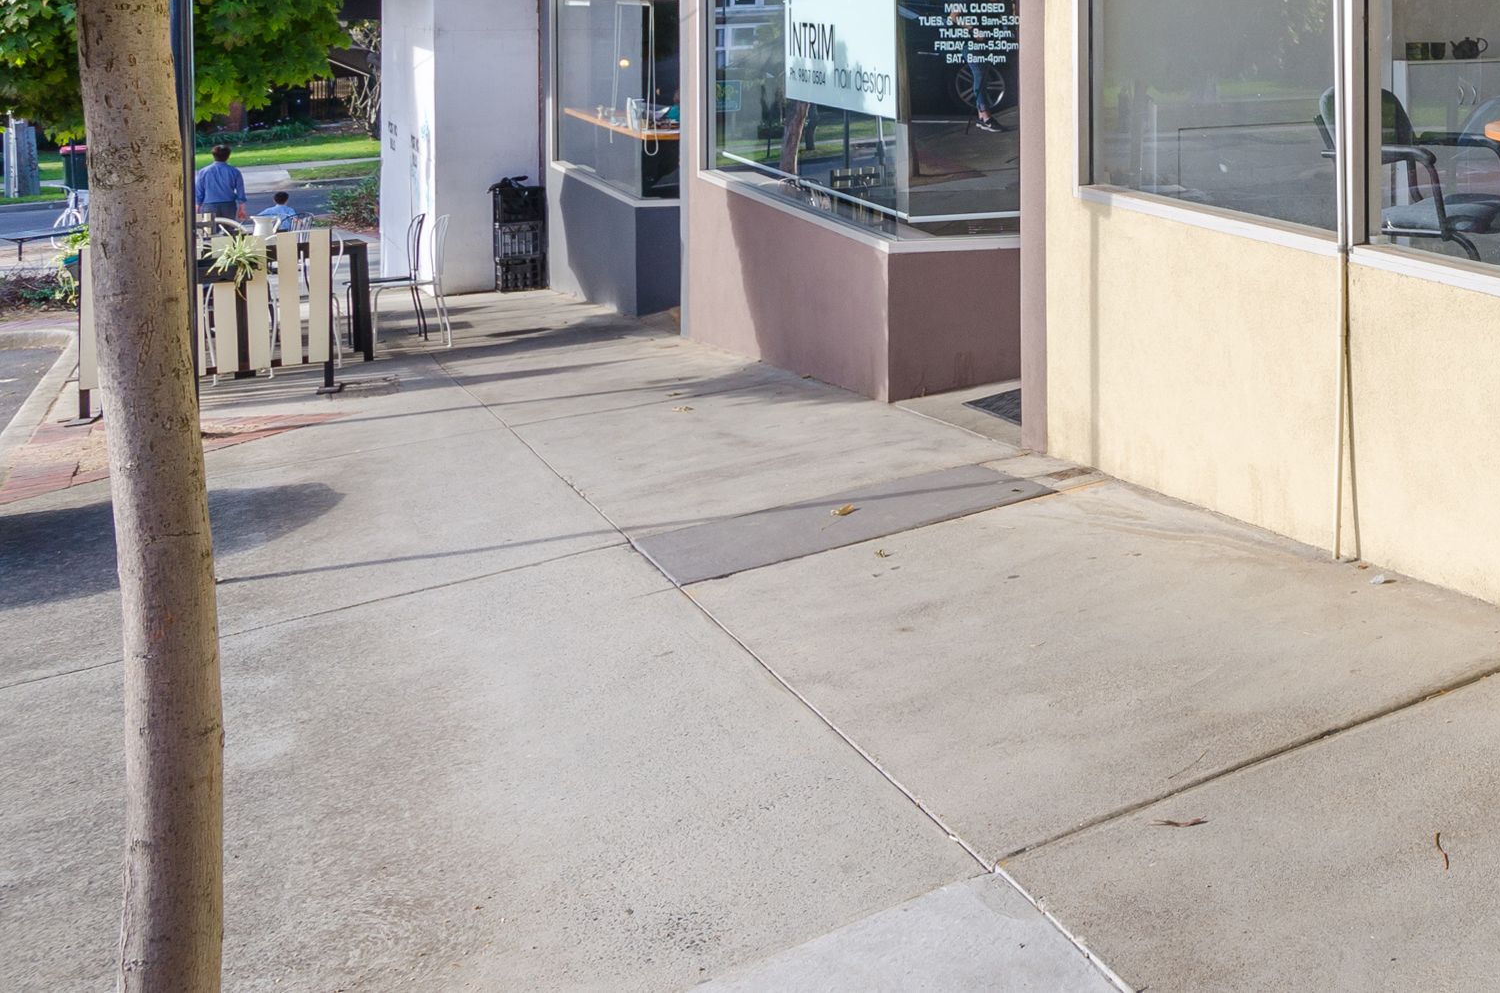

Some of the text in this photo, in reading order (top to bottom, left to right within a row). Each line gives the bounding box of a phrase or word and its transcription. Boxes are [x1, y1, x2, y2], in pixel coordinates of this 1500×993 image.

[944, 3, 1005, 13] MON. CLOSED
[918, 16, 944, 26] TUES.
[956, 16, 980, 26] WED.
[939, 28, 1012, 40] THURS. 9am-8pm
[934, 40, 1019, 52] FRIDAY 9am-5.30pm
[946, 53, 965, 64] SAT.
[854, 63, 892, 102] design
